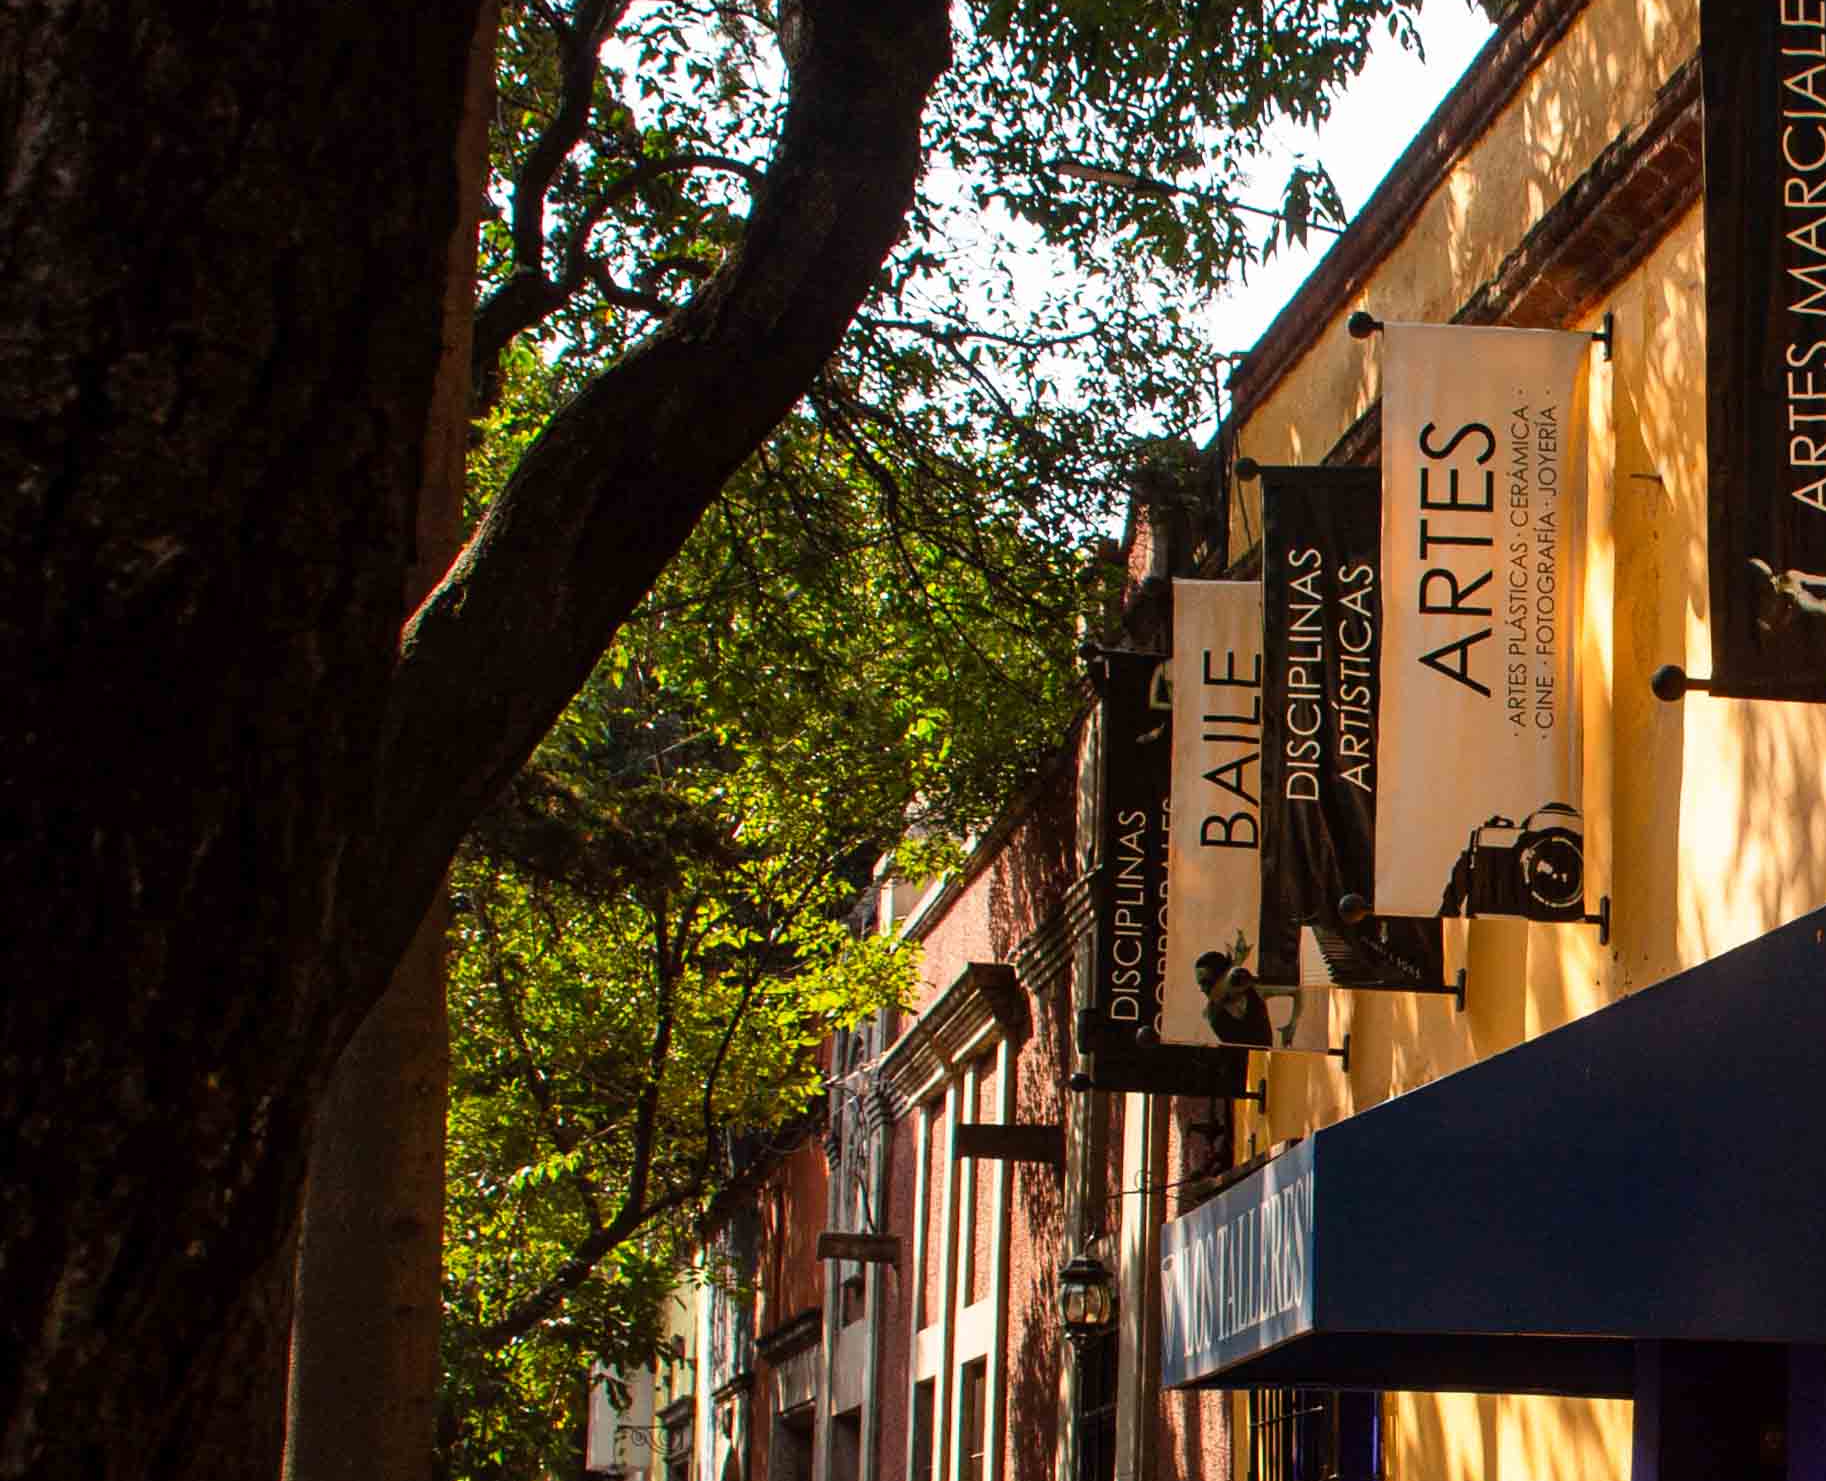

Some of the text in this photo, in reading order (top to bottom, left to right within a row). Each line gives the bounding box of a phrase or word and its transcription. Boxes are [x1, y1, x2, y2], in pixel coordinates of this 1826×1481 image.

[1286, 548, 1323, 801] DISCIPLINAS
[1331, 564, 1374, 792] ARTÍSTICAS
[1418, 422, 1496, 698] ARTES
[1505, 405, 1530, 727] ARTES PLÁSTICAS CERÁMICA
[1534, 406, 1558, 729] CINE FOTOGRAFÍA JOYERÍA
[1201, 648, 1262, 850] BAILE
[1110, 810, 1146, 1021] DISCIPLINAS
